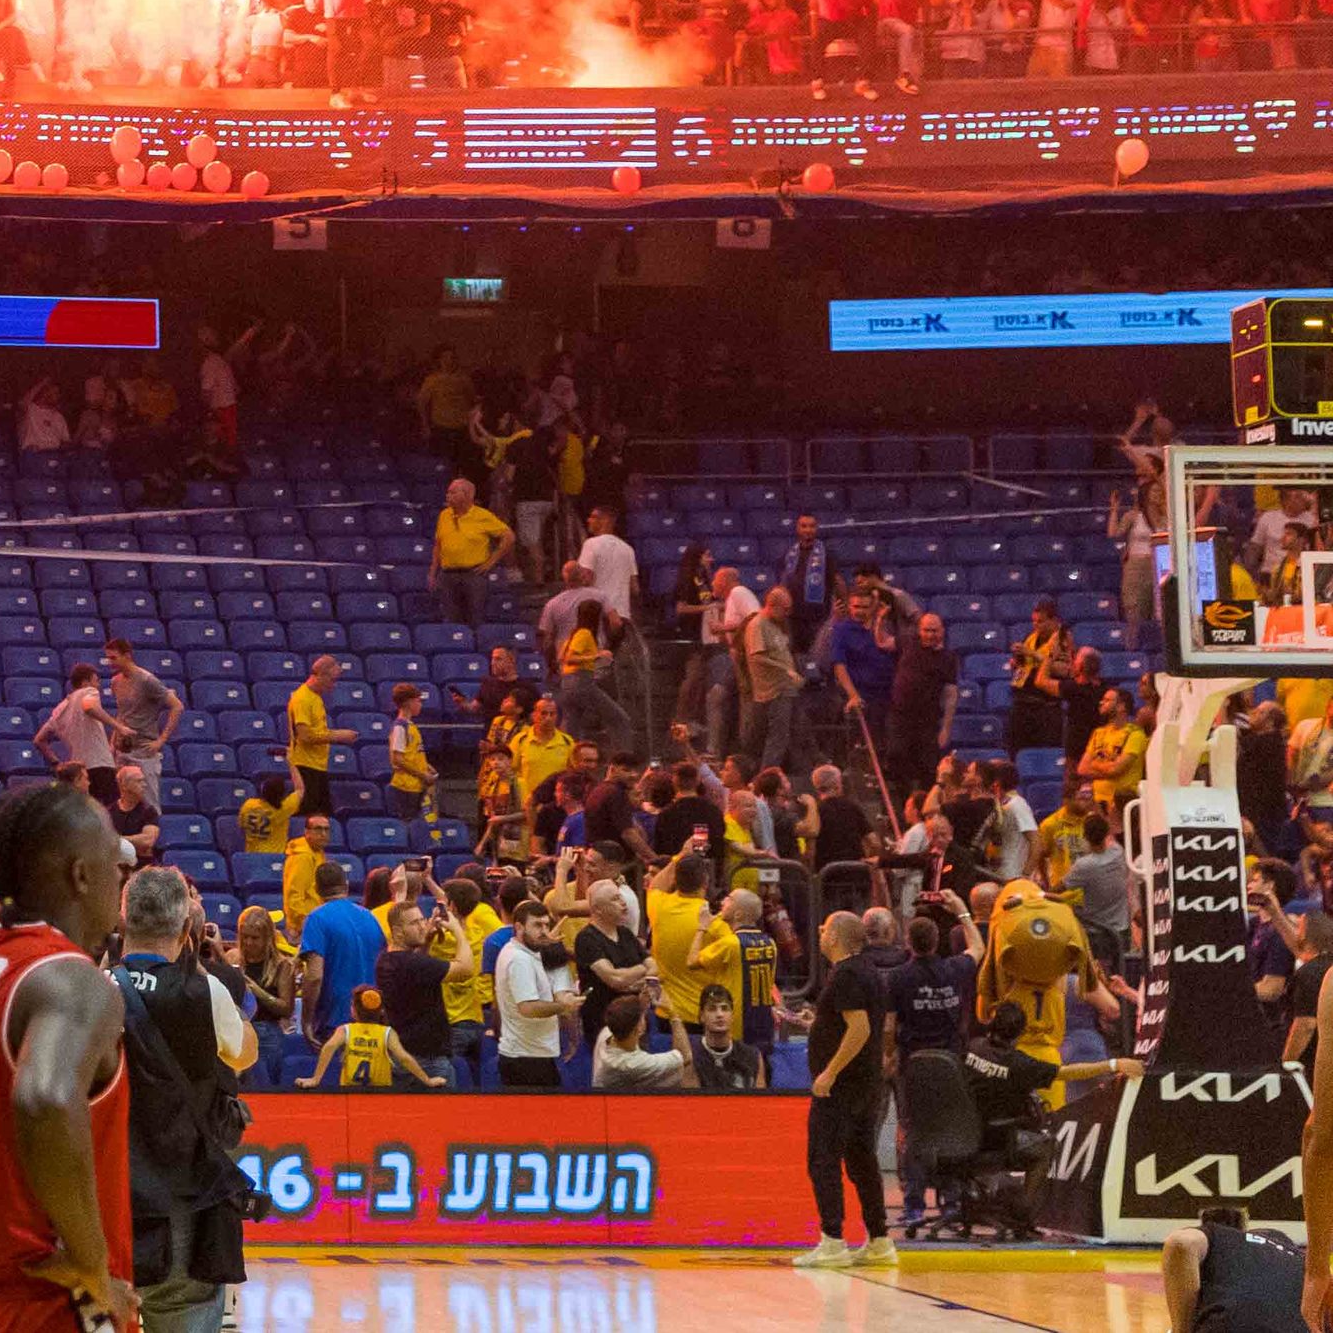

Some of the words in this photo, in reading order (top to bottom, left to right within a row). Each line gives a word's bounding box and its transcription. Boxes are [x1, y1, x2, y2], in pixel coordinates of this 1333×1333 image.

[246, 814, 272, 836] 52
[1174, 834, 1237, 851] KIA
[1175, 865, 1238, 882] KIA
[1177, 895, 1239, 912] KIA
[1174, 944, 1246, 963] KIA
[352, 1060, 371, 1085] 4
[1160, 1071, 1282, 1103] KIA
[444, 1151, 652, 1214] השבוע
[1134, 1154, 1303, 1198] KIA
